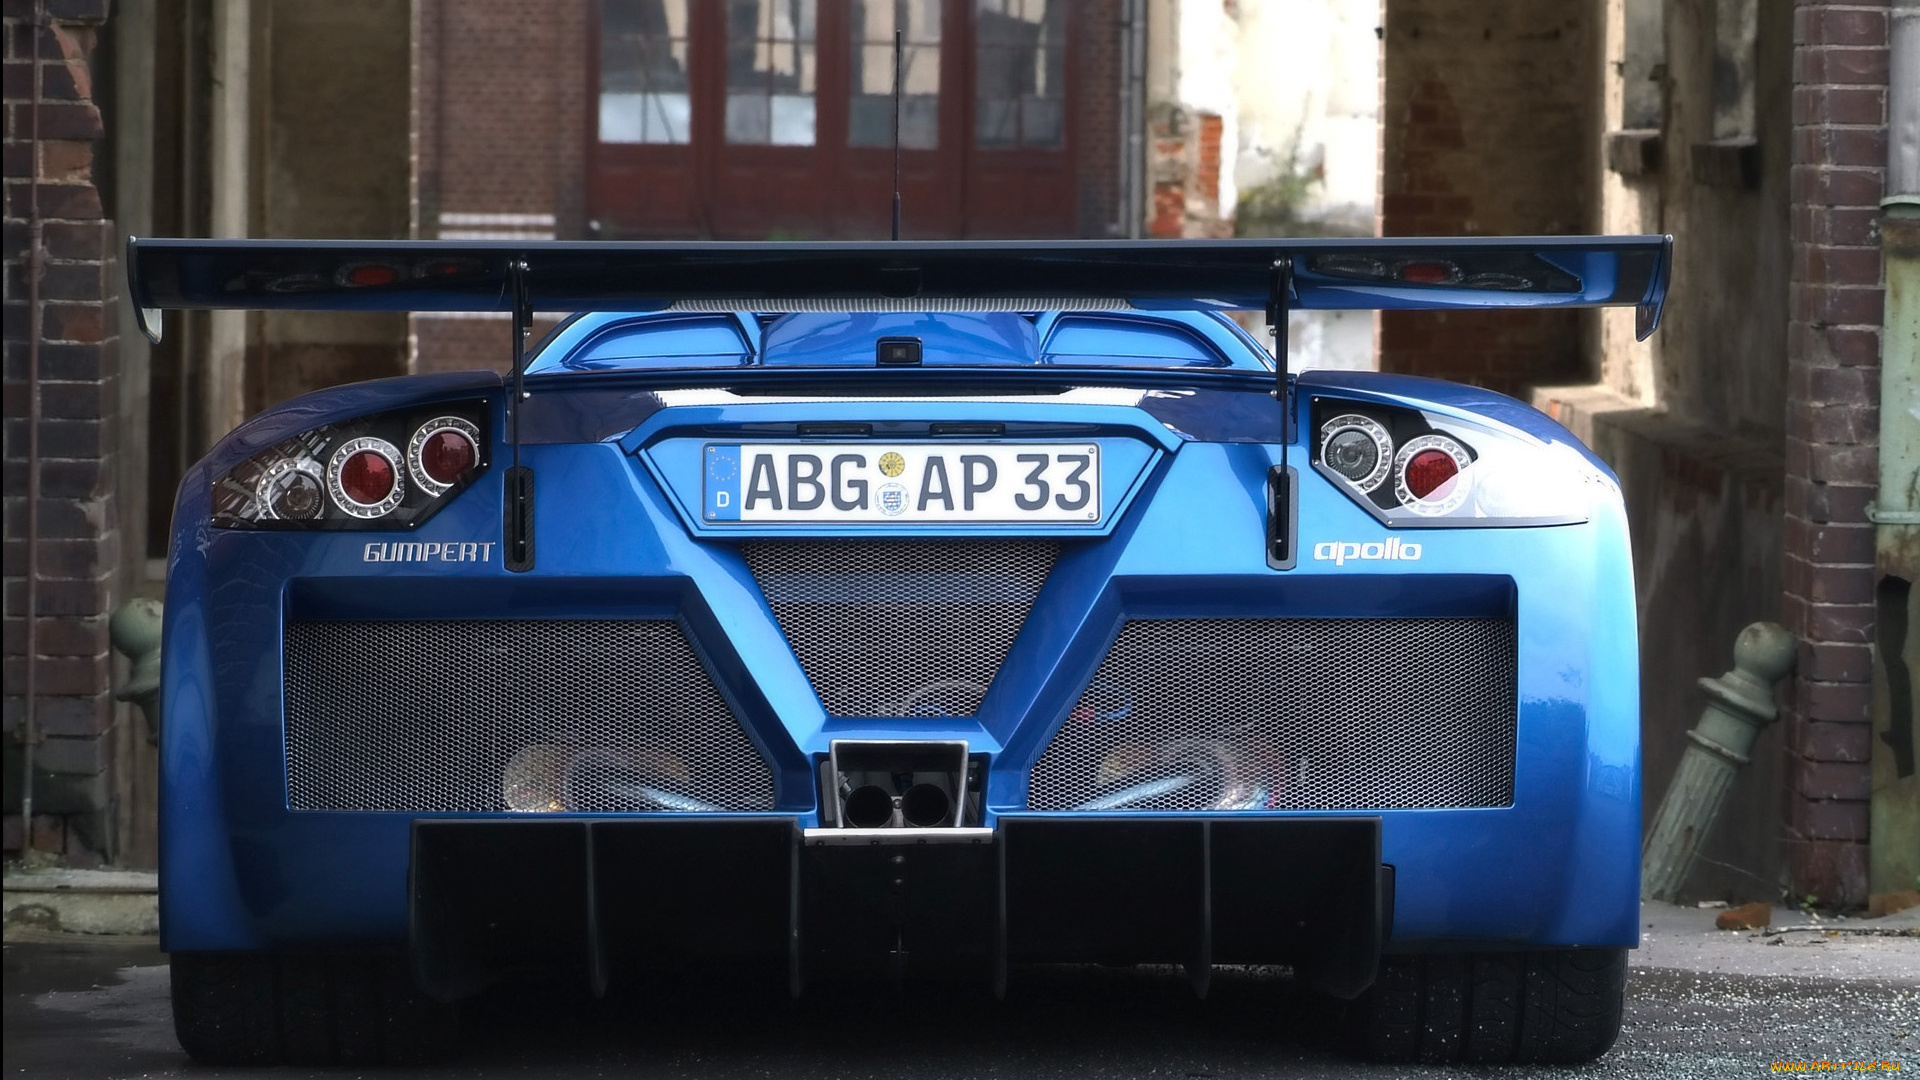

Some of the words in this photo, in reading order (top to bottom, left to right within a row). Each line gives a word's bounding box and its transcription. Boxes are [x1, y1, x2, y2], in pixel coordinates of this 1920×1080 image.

[744, 453, 869, 511] ABG
[917, 454, 998, 511] AP
[1014, 454, 1091, 511] 33
[716, 491, 730, 507] D
[363, 541, 496, 563] GUMPERT
[1313, 536, 1422, 566] apollo
